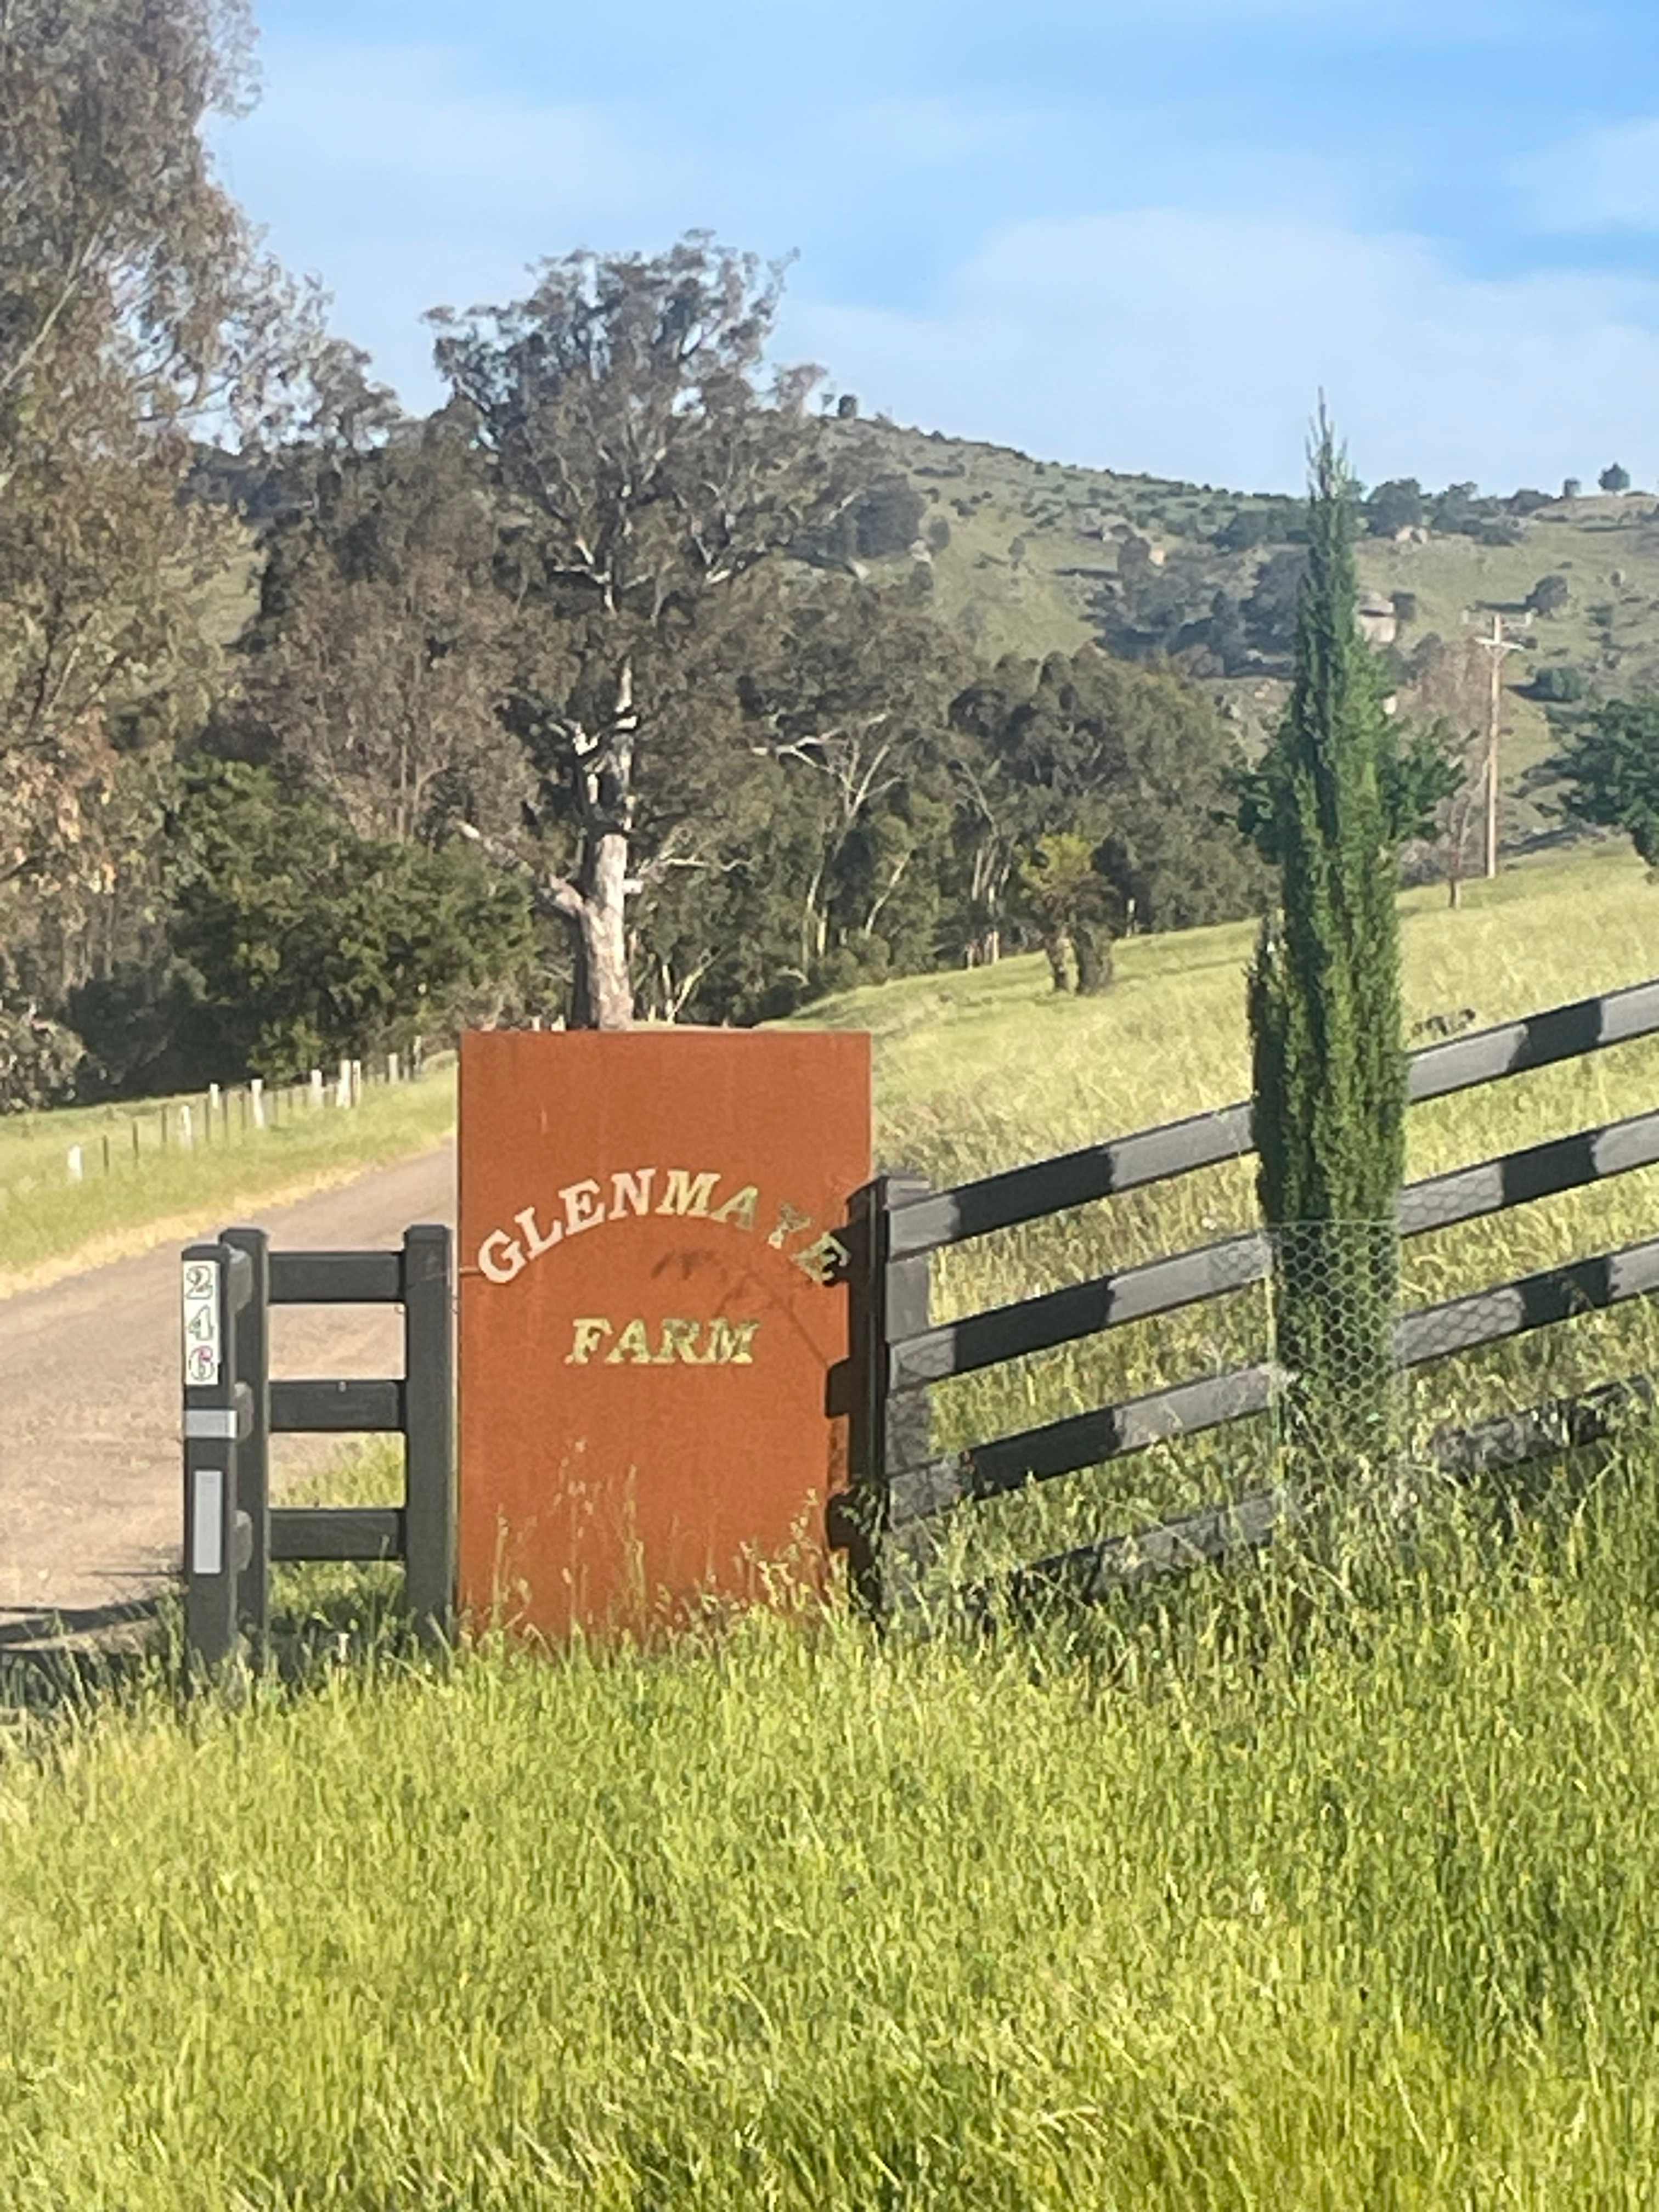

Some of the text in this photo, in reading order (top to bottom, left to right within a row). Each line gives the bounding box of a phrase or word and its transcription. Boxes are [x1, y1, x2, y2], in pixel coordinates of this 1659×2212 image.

[478, 1168, 851, 1284] GLENMAYE
[186, 1265, 215, 1381] 246
[564, 1318, 760, 1364] FARM
